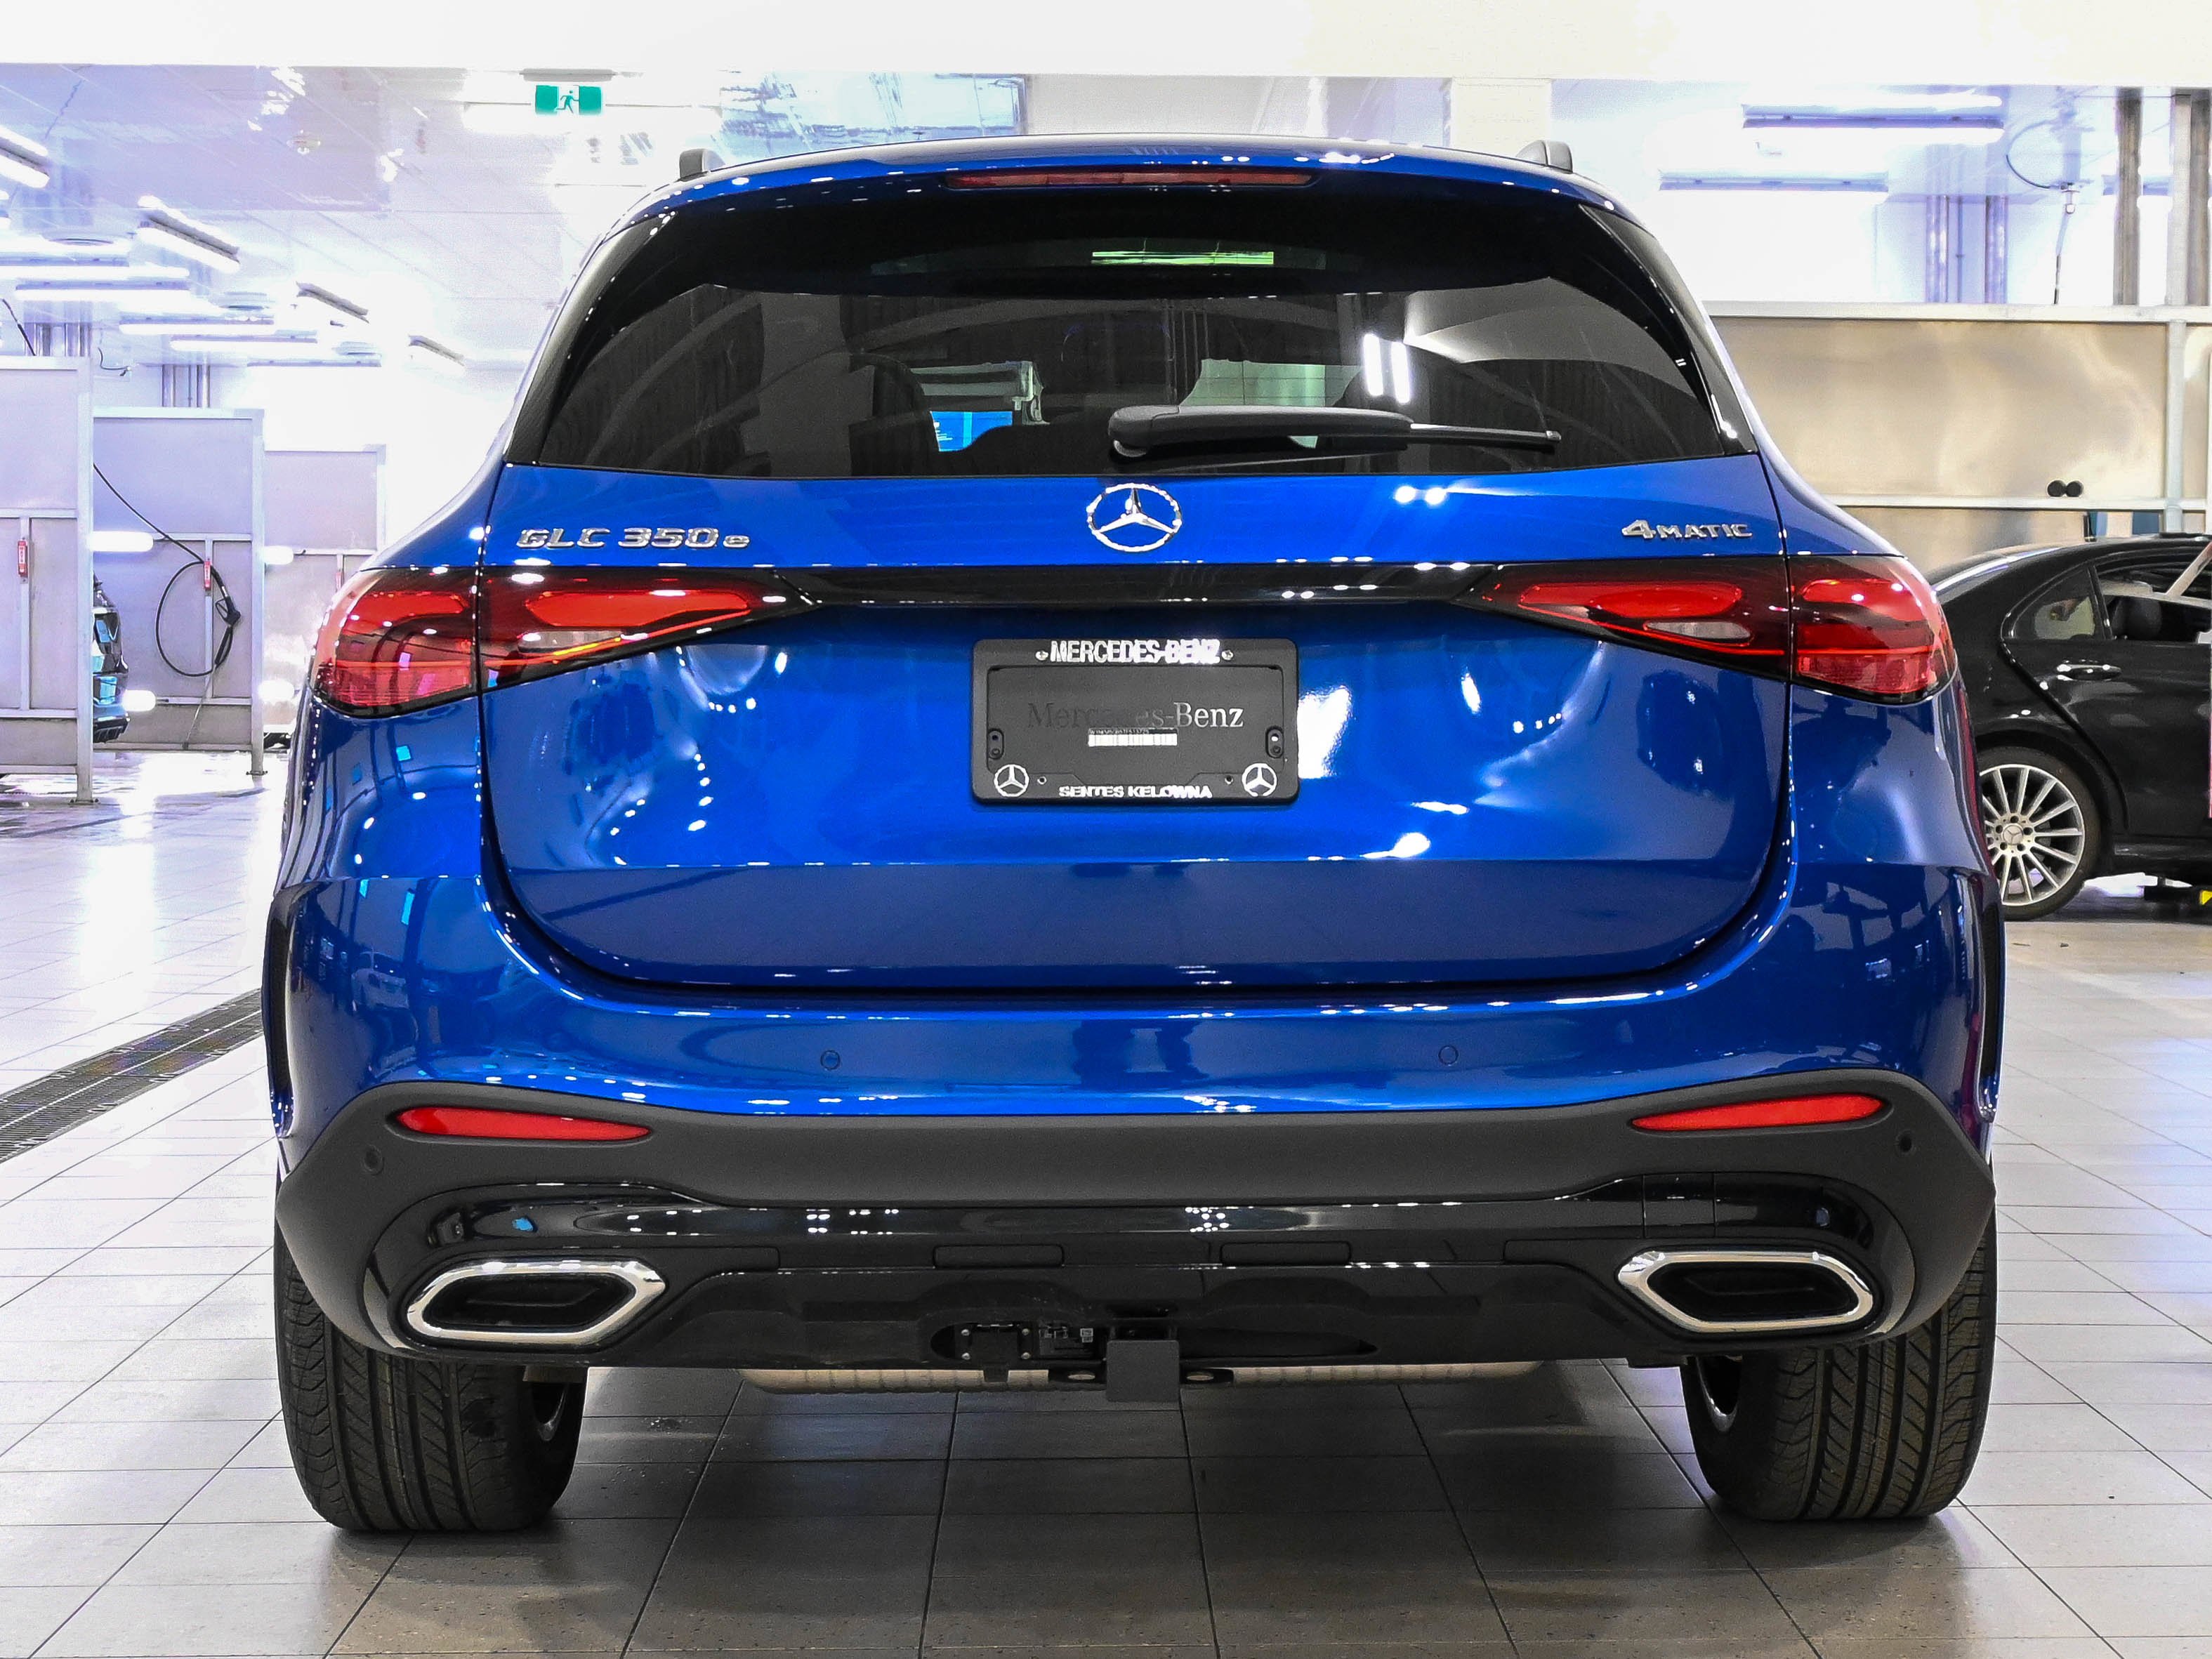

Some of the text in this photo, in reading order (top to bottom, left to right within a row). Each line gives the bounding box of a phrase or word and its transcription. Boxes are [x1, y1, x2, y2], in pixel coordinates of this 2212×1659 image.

[516, 527, 611, 549] GLC
[1621, 520, 1753, 539] 4MATIC
[1050, 639, 1220, 664] MERCEDES-BENZ
[1027, 702, 1245, 728] Merces-Benz
[1059, 785, 1213, 798] SENTES KELOWNA
